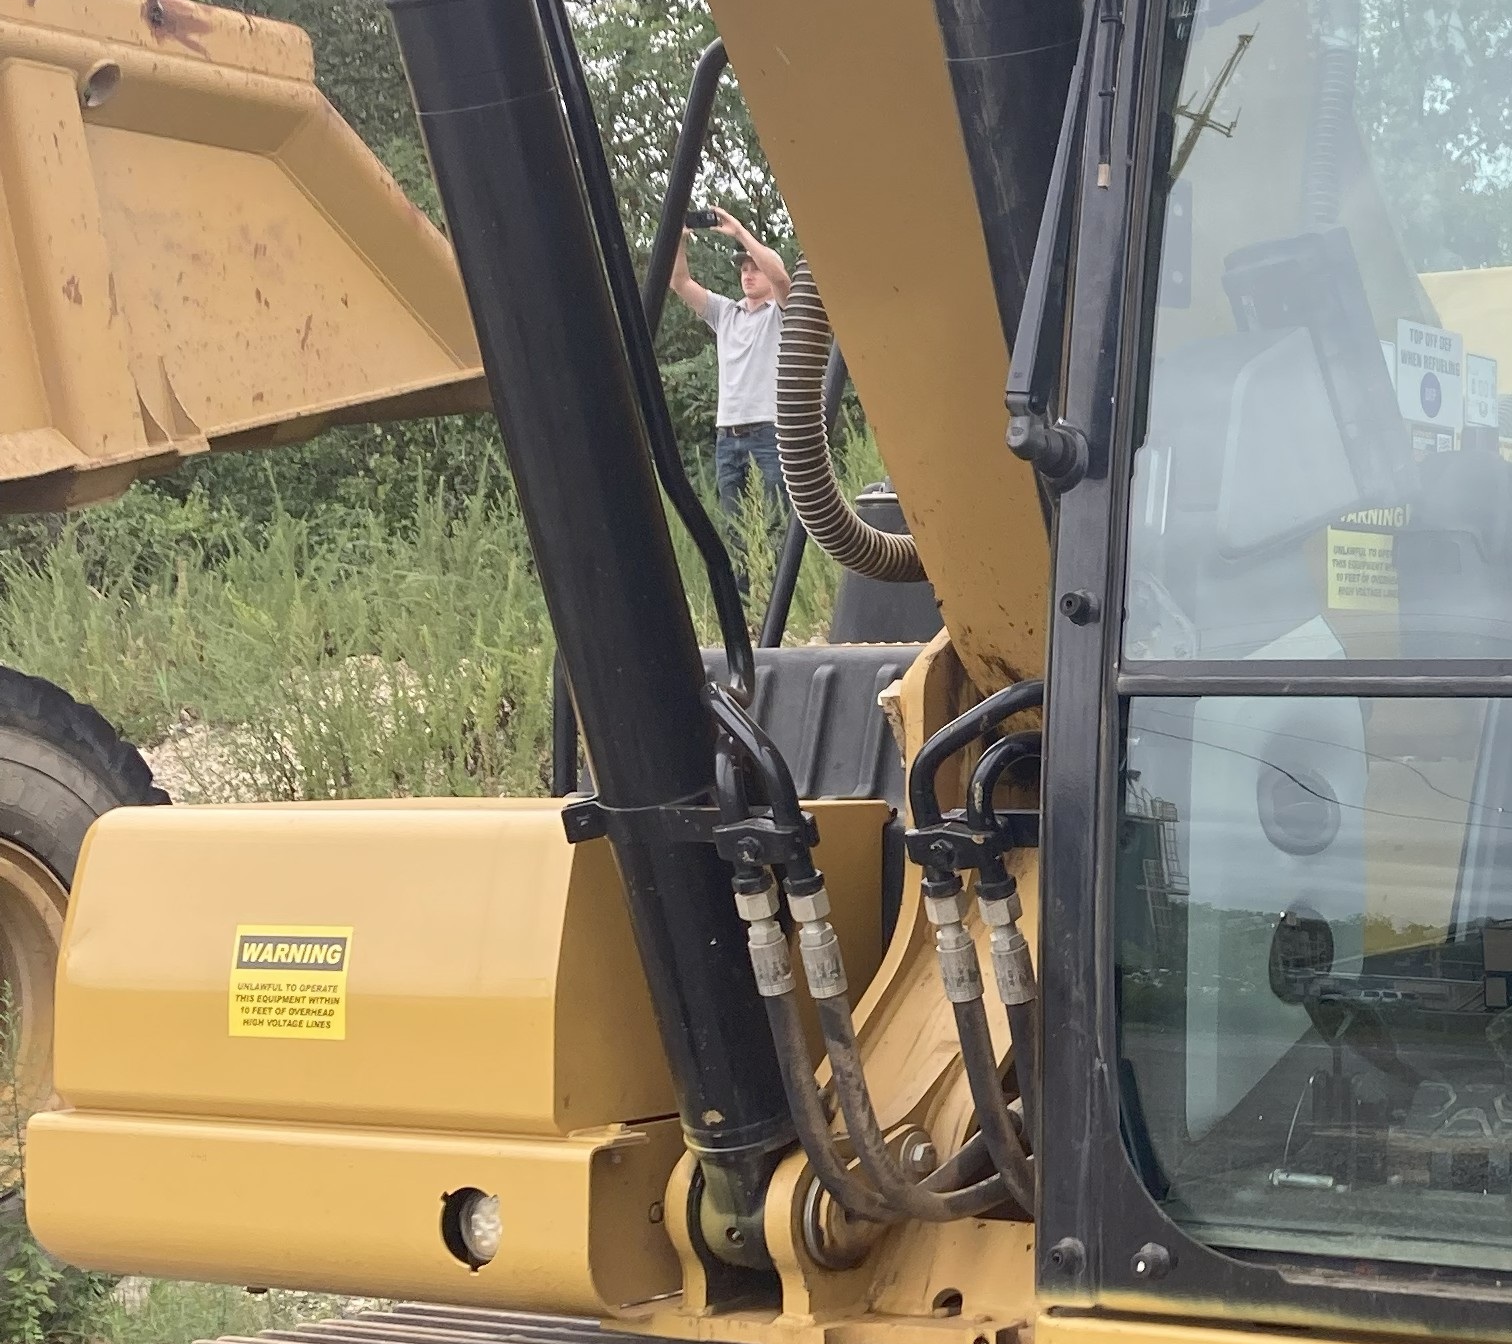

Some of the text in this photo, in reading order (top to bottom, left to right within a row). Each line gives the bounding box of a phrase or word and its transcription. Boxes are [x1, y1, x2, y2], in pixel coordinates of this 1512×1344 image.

[1410, 328, 1423, 344] TOP
[1425, 333, 1437, 348] OFF
[1401, 349, 1460, 376] WHEN REFUELING
[242, 942, 343, 965] WARNING
[237, 982, 339, 994] UNLAWFUL TO OPERATE
[235, 994, 340, 1005] THIS EQUIPMENT WITHIN
[240, 1006, 335, 1017] 10 FEET OF OVERHEAD
[242, 1018, 332, 1029] HIGH VOLTAGE LINES
